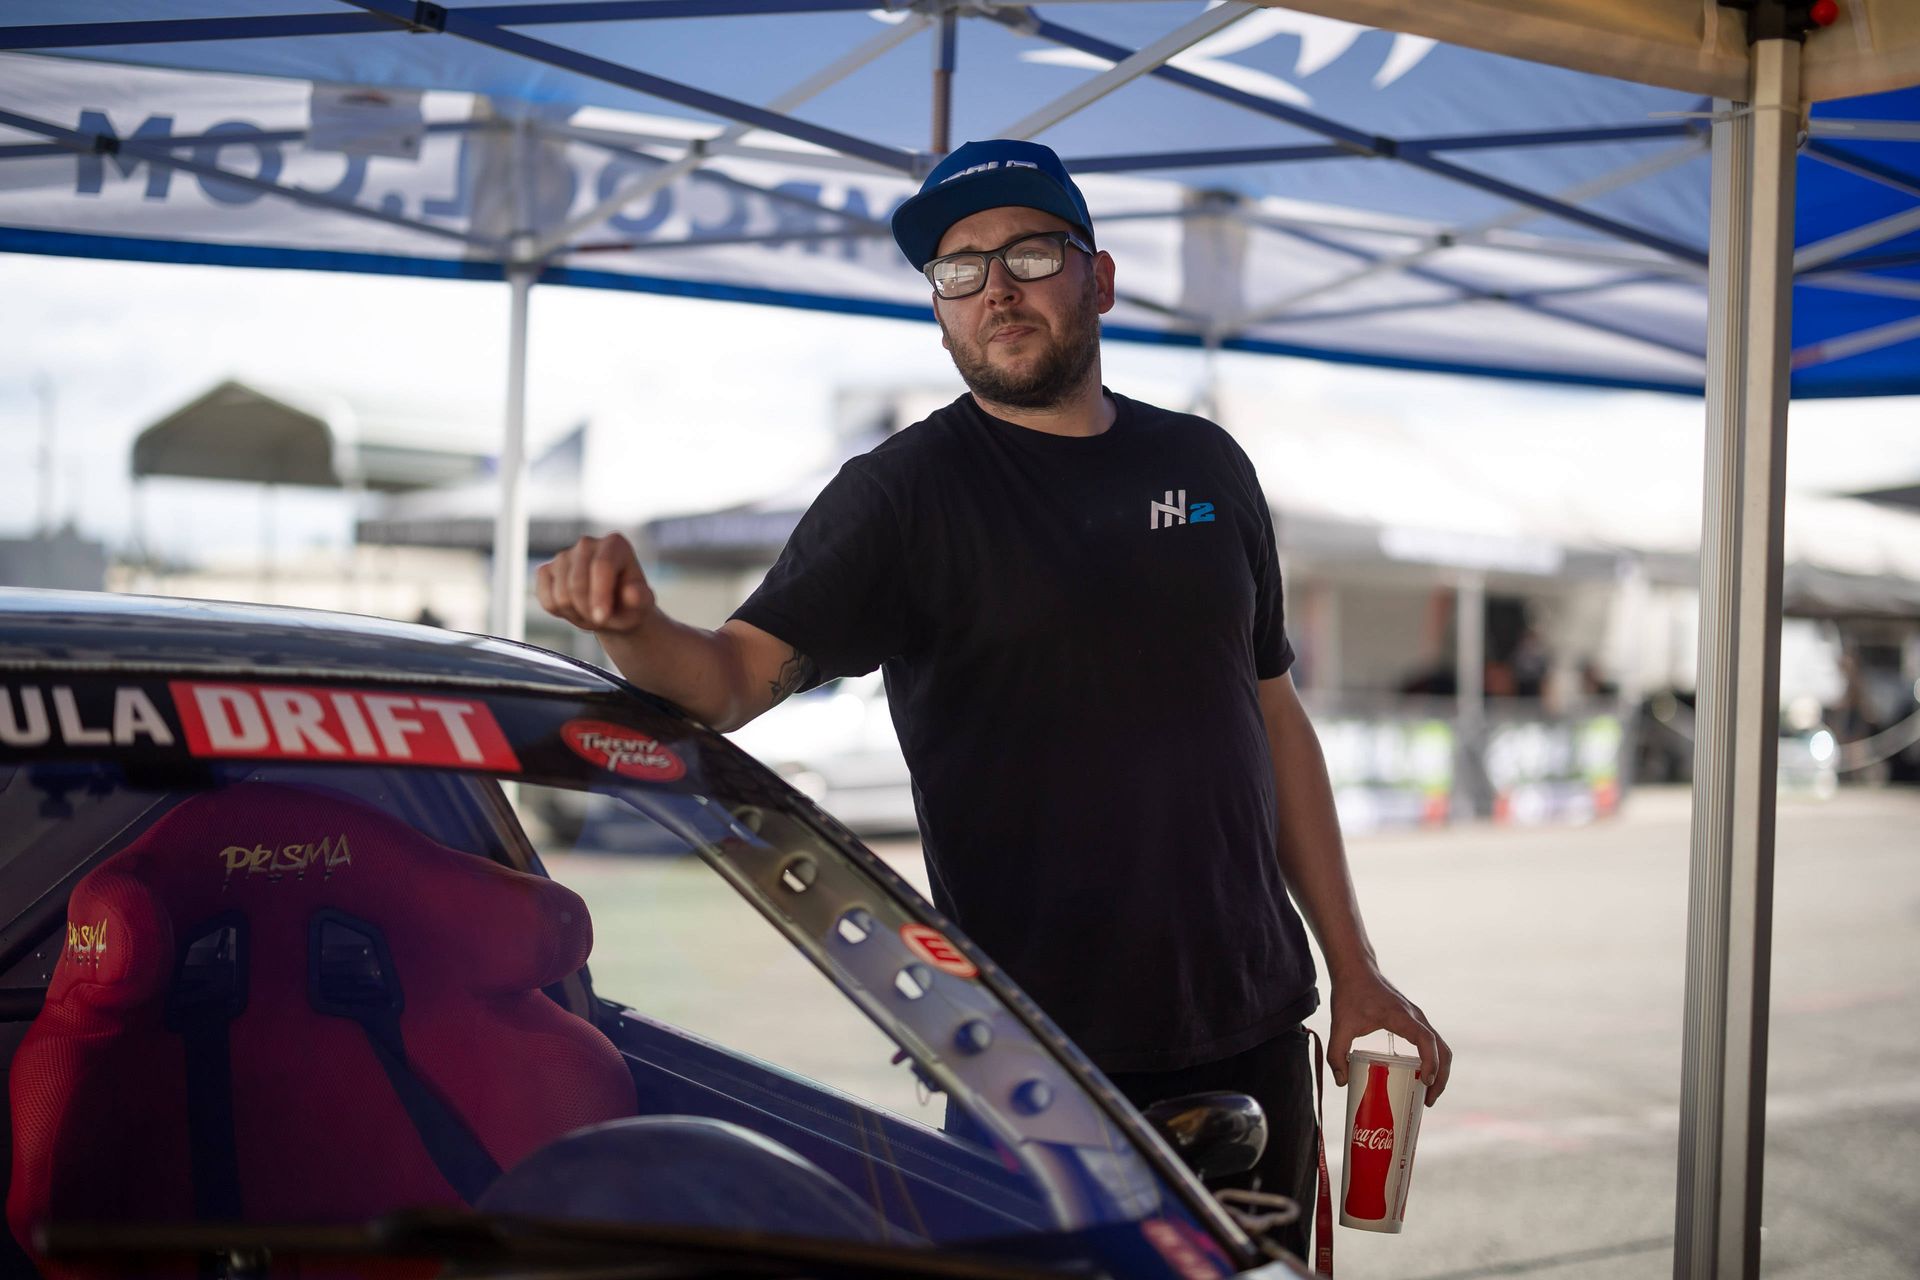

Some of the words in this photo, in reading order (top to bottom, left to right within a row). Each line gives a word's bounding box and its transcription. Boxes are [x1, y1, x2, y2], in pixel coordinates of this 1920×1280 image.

[0, 686, 175, 745] ULA
[192, 686, 485, 764] DRIFT
[576, 732, 658, 752] TWENTY
[602, 747, 672, 772] YEARS
[219, 833, 351, 882] PRISMA
[1353, 1124, 1393, 1150] ca-Cola
